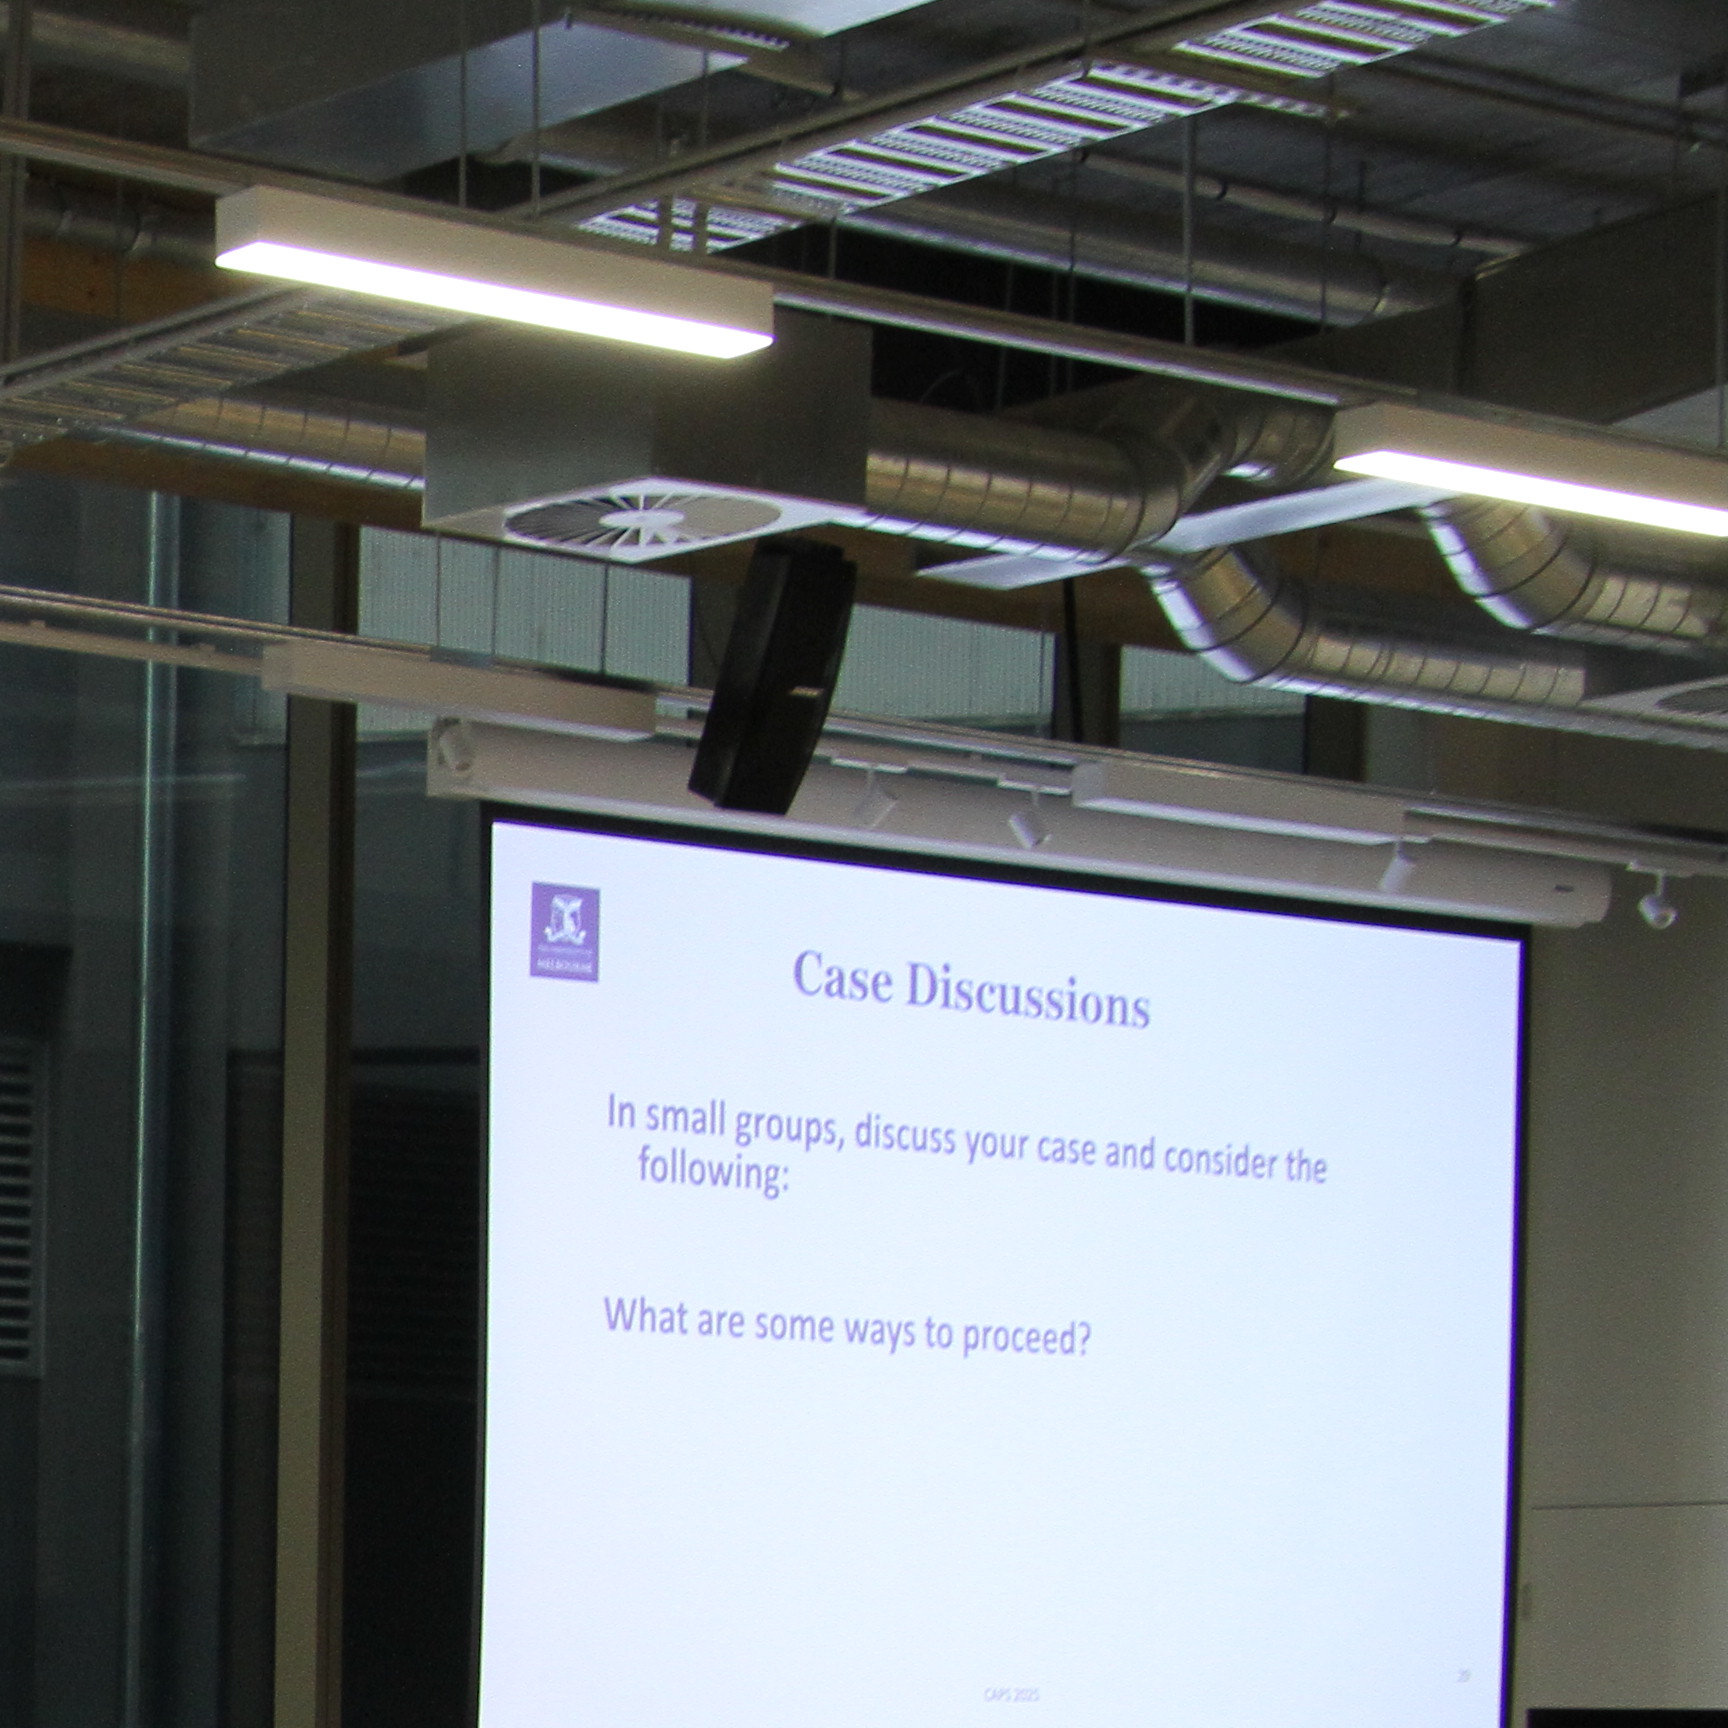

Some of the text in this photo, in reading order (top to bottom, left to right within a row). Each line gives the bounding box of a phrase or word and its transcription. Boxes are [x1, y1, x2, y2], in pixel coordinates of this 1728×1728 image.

[794, 950, 1152, 1029] Case Discussions
[608, 1092, 1328, 1184] In small groups, discuss your case and consider the
[638, 1143, 790, 1201] following:
[603, 1295, 1092, 1360] What are some ways to proceed?
